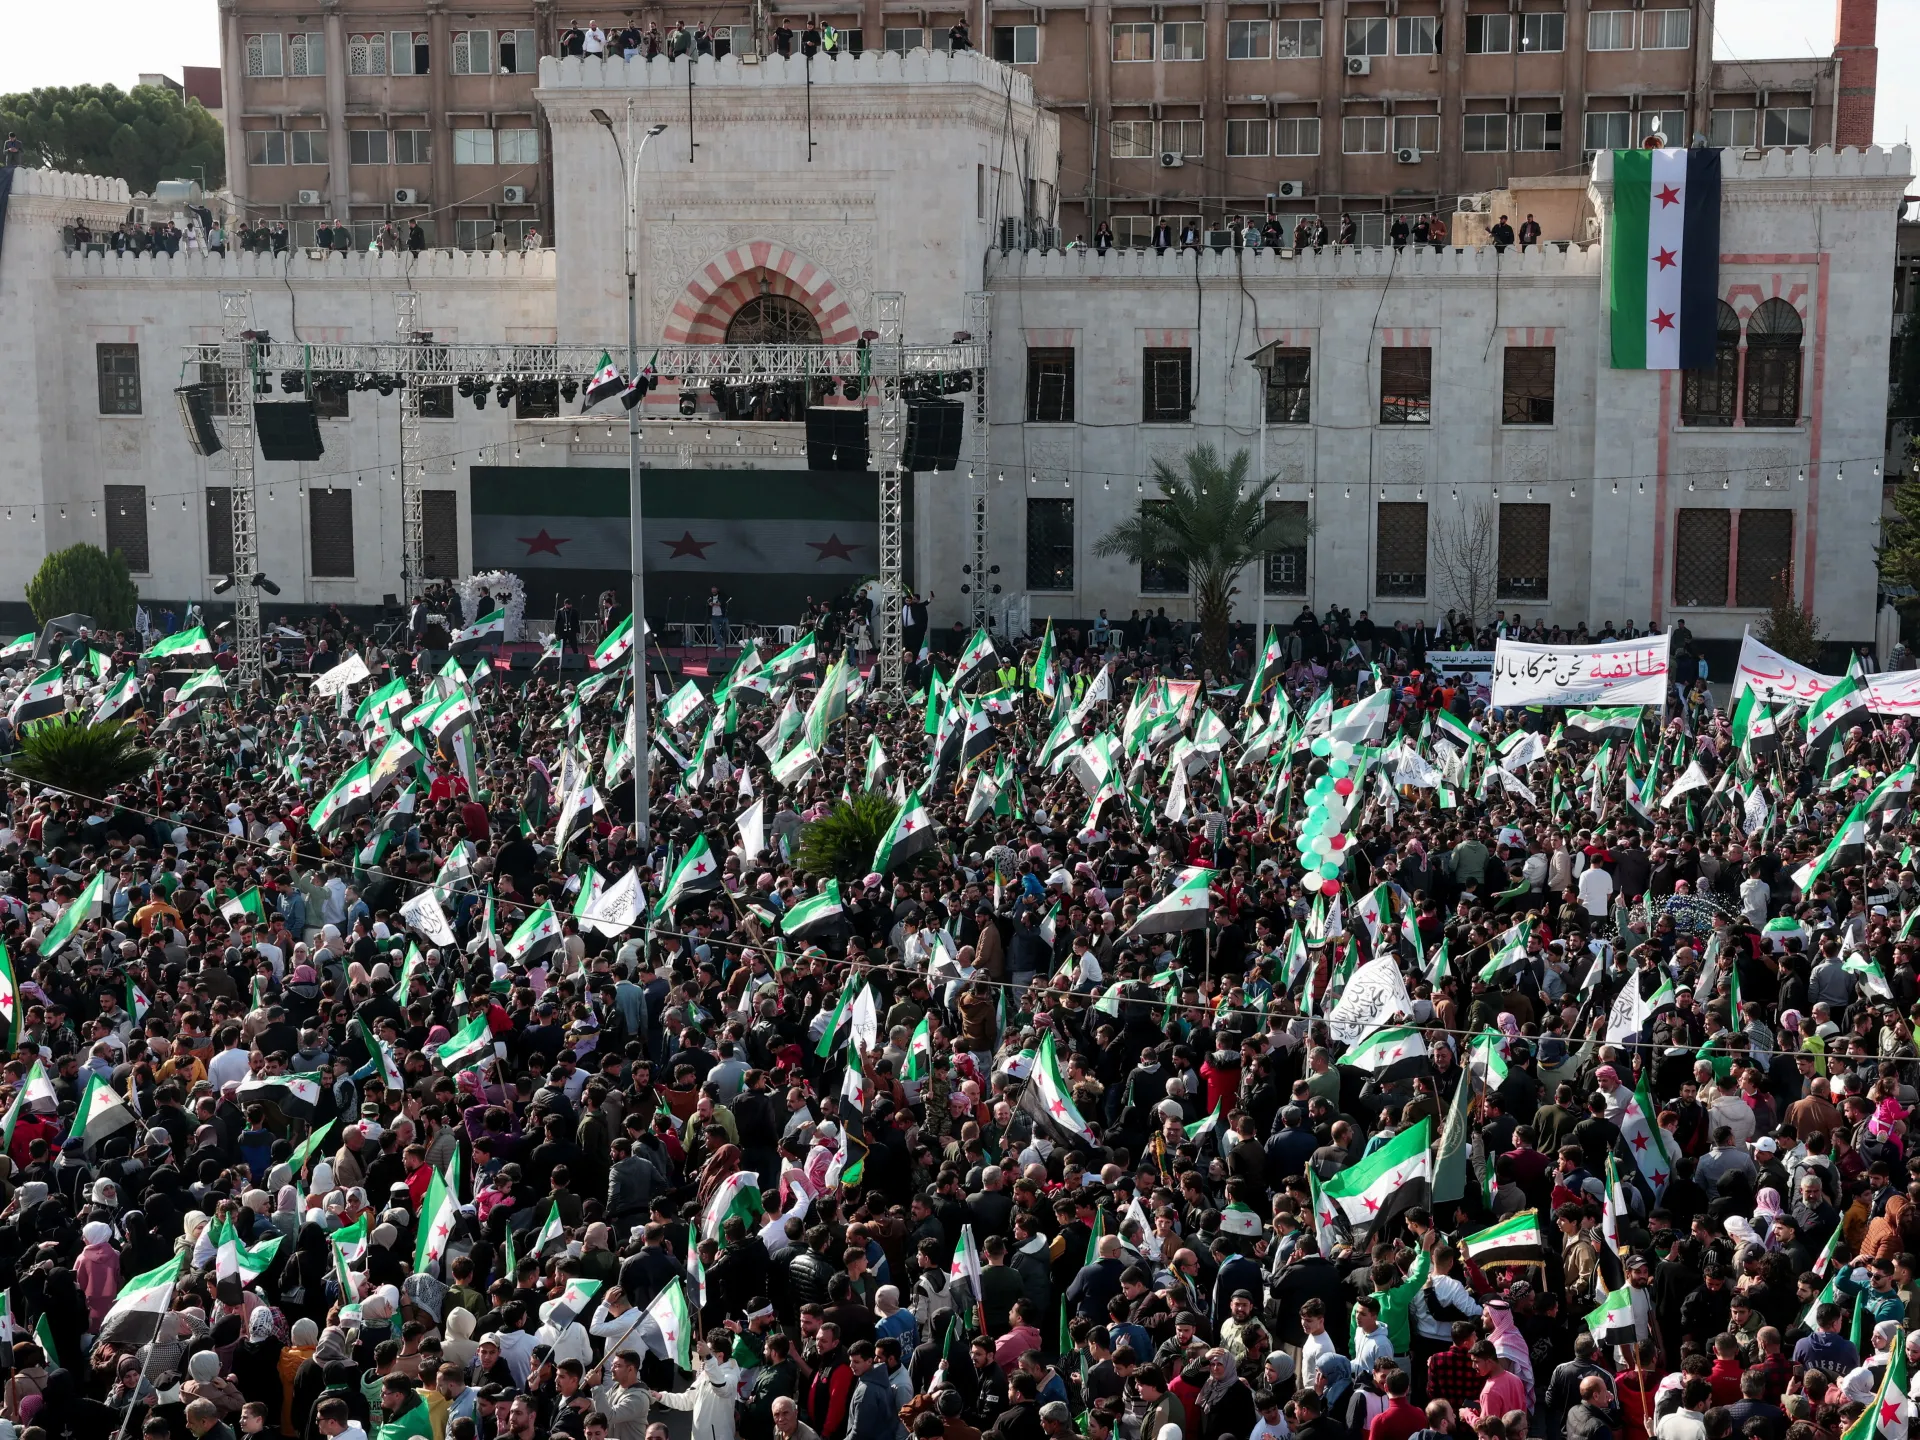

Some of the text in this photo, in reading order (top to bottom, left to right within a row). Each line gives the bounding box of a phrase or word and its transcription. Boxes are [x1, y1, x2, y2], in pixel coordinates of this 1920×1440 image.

[1432, 654, 1459, 664] الهاشمية
[1470, 655, 1483, 664] بني
[1520, 653, 1558, 684] شركاء
[1554, 654, 1584, 687] نحن
[1807, 1360, 1848, 1375] DIESEL
